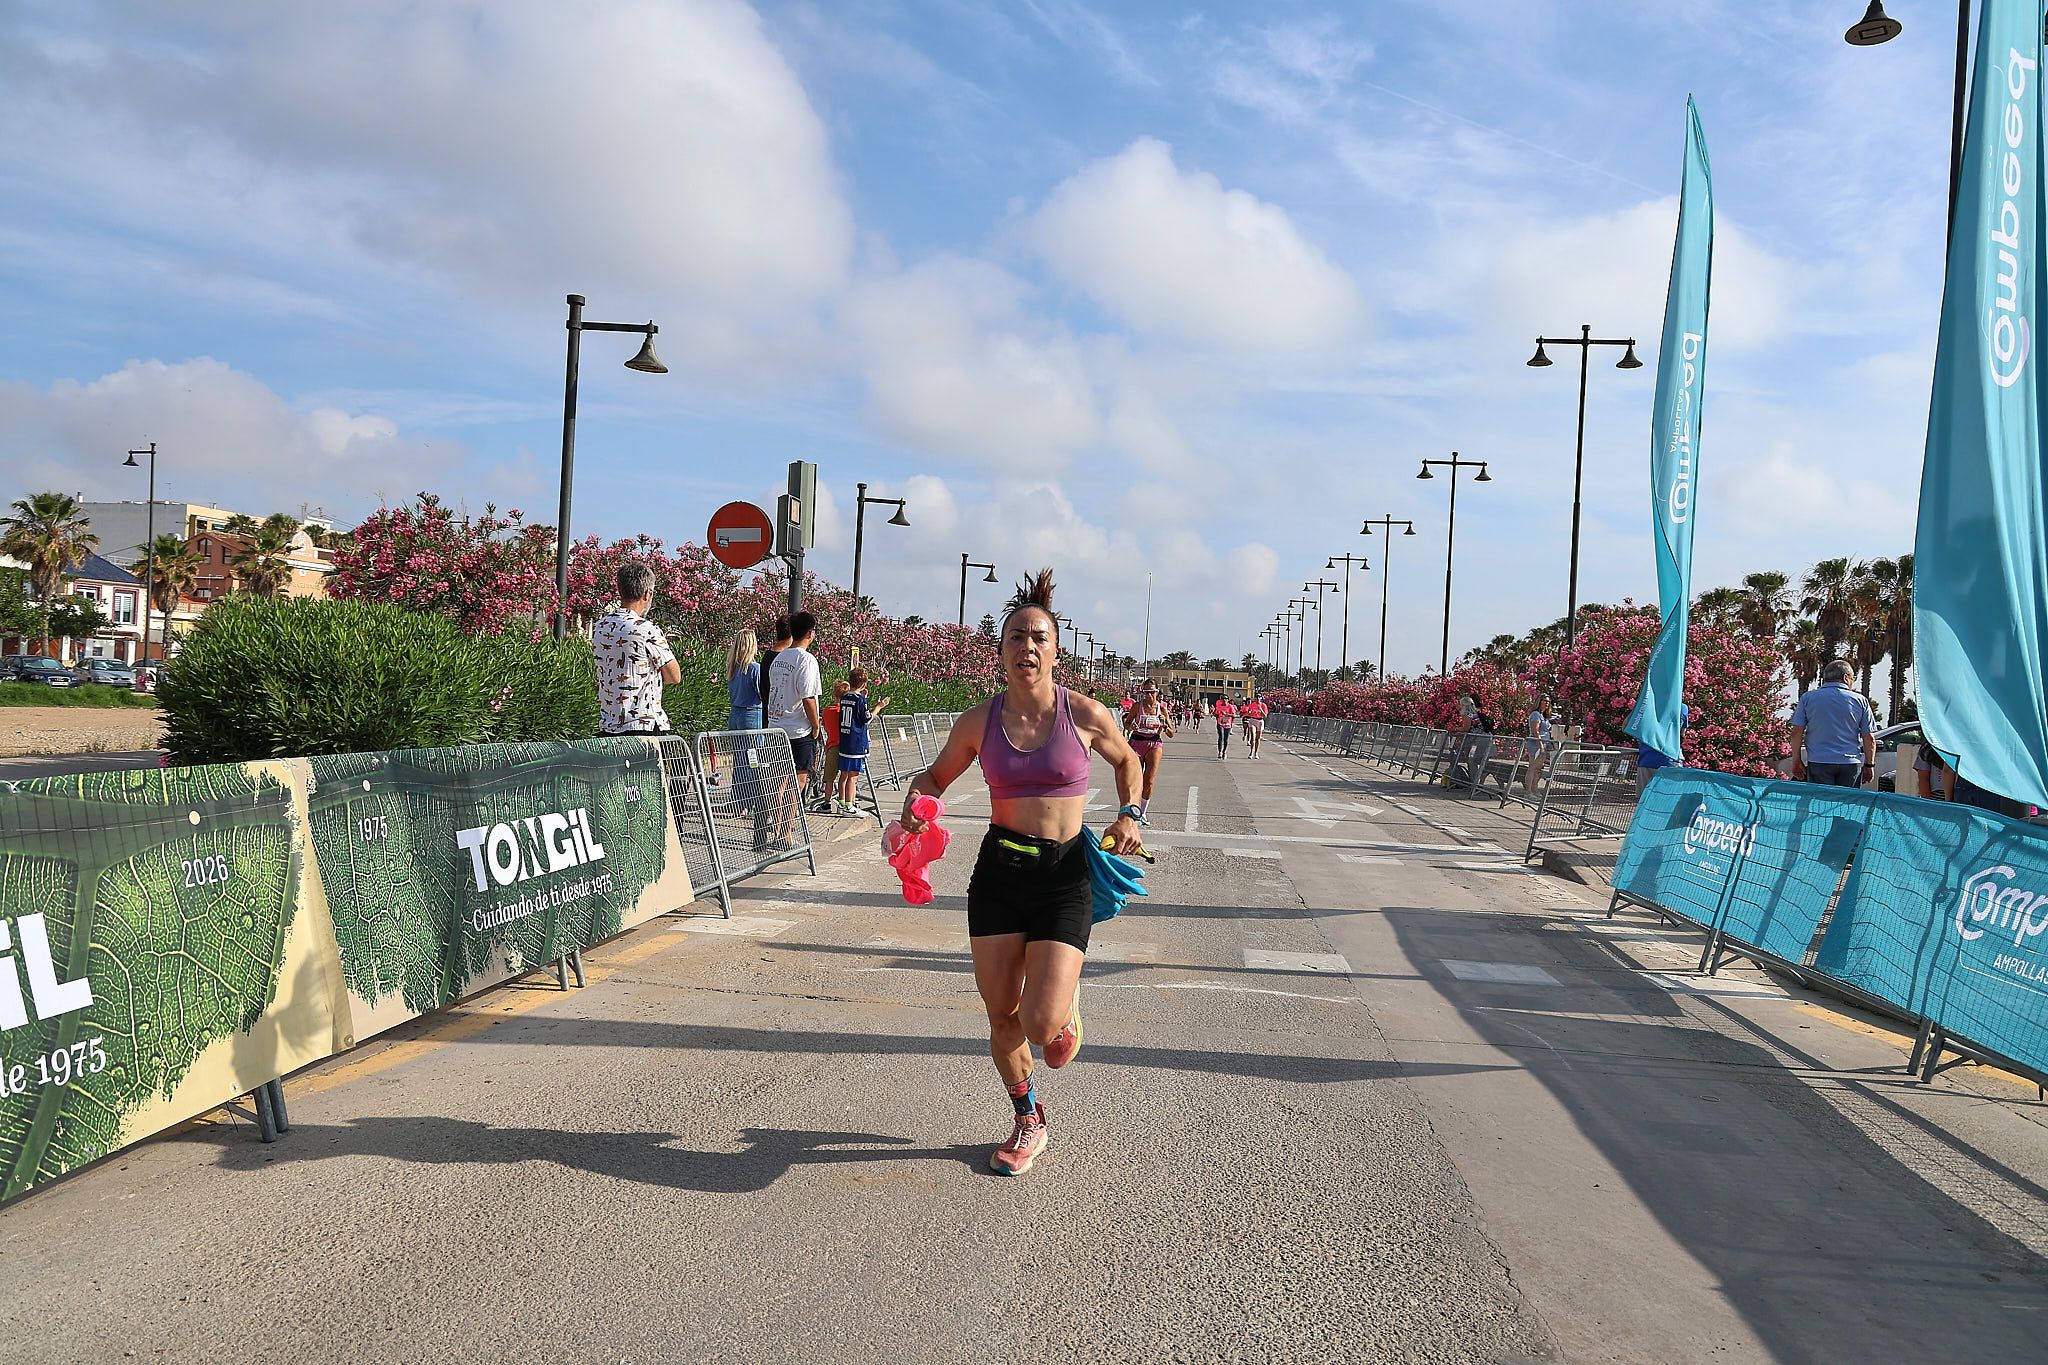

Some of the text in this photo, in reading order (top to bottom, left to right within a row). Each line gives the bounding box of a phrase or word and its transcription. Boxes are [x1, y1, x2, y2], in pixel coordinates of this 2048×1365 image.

[841, 706, 853, 728] 10
[358, 816, 387, 841] 1975
[1684, 803, 1760, 857] Compeed
[181, 854, 228, 888] 2026
[473, 873, 613, 931] Cuidando de ti desde 1975
[34, 1034, 106, 1087] 1975
